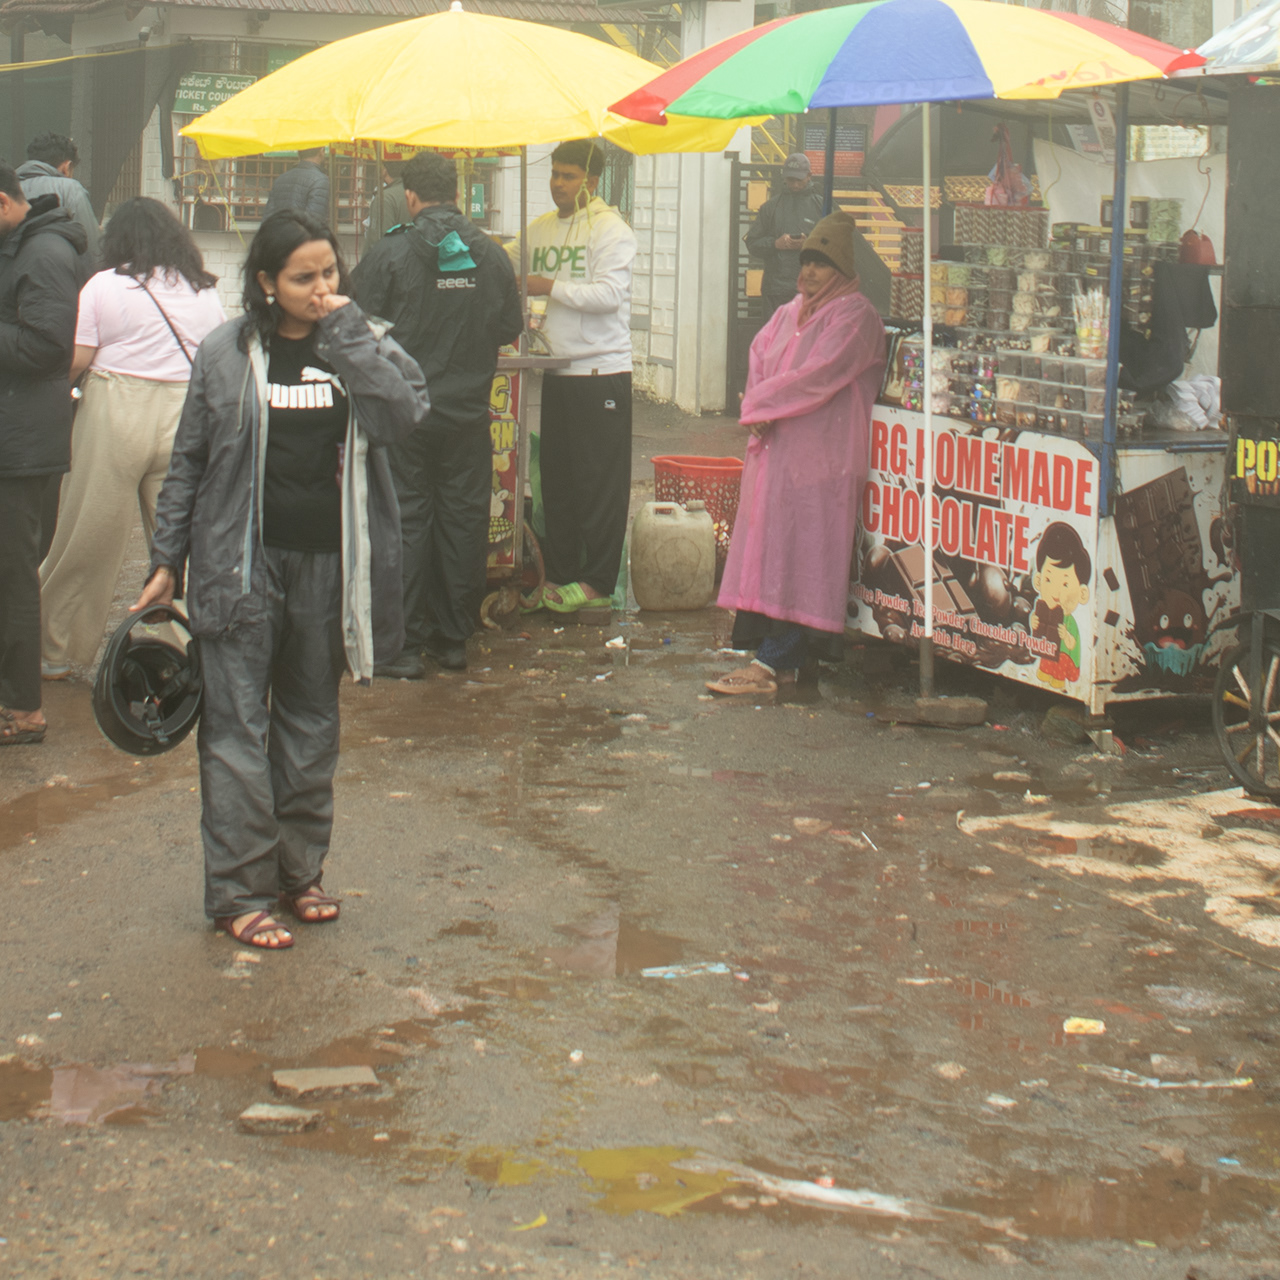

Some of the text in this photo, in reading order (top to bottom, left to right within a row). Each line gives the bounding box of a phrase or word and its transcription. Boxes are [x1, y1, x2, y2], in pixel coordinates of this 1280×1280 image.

[175, 89, 236, 101] TICKET COUN
[192, 103, 208, 112] Rs.
[532, 245, 587, 272] HOPE
[267, 382, 334, 409] UMA
[862, 480, 1030, 572] CHOCOLATE
[874, 588, 912, 616] Powder,
[931, 606, 968, 633] Powder,
[969, 616, 1018, 646] Chocolate
[1019, 635, 1058, 657] Powder
[910, 620, 977, 655] Avaable Here
